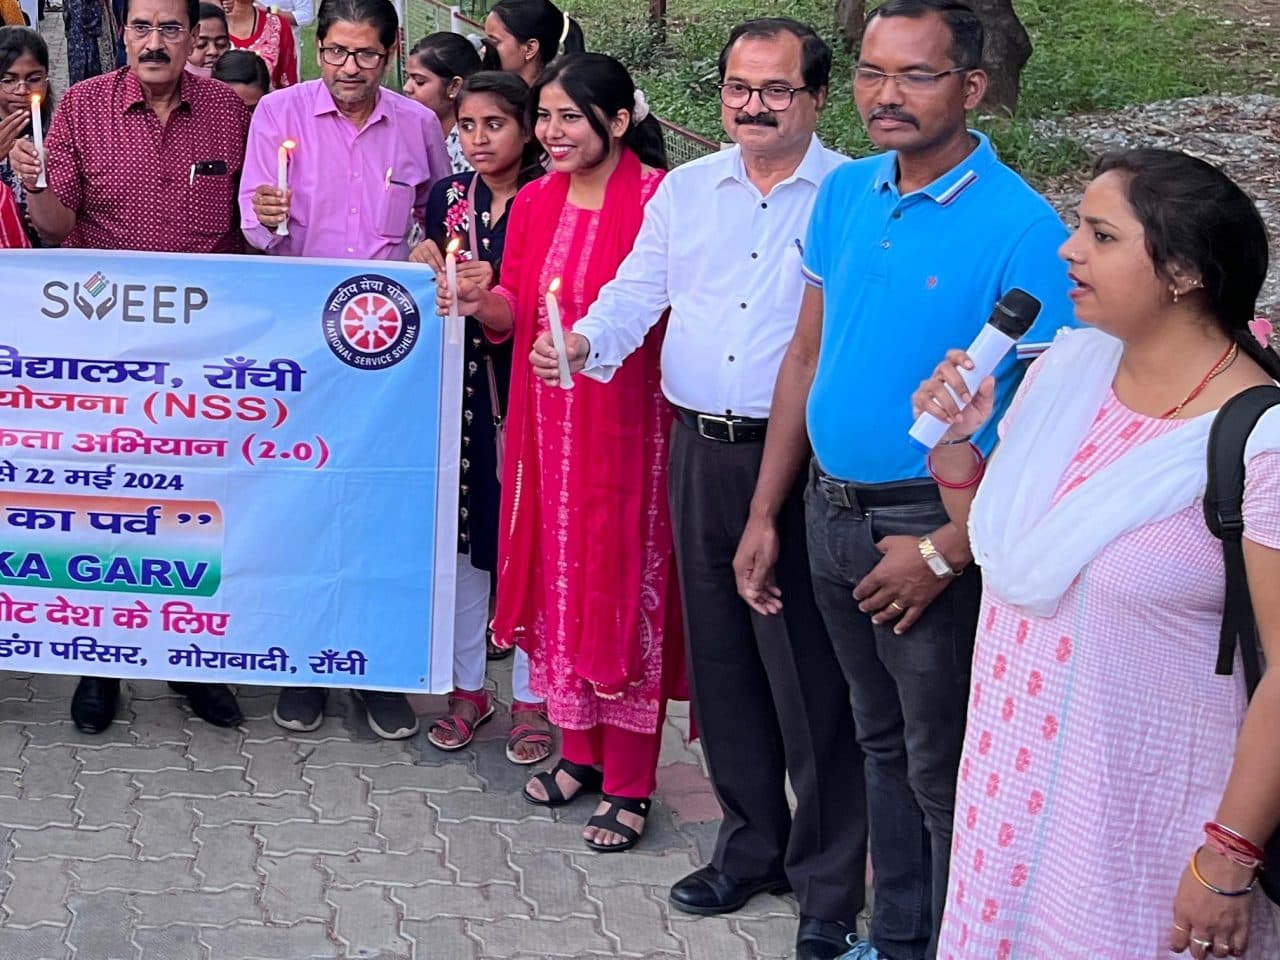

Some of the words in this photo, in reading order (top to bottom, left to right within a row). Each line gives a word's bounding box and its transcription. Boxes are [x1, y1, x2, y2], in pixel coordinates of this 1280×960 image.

[359, 276, 384, 292] सेवा
[387, 284, 416, 315] योजना
[326, 319, 354, 361] NATIONAL
[354, 353, 393, 366] SERVICE
[391, 324, 417, 359] SCHEME
[203, 355, 307, 392] राँची
[142, 391, 289, 429] (NSS)
[71, 427, 228, 458] अभियान
[241, 432, 330, 470] (2.0)
[25, 467, 56, 484] 22
[64, 463, 116, 490] मई
[122, 471, 185, 491] 2024
[5, 508, 77, 532] का
[87, 505, 162, 536] पर्व
[67, 554, 209, 589] GARV
[44, 595, 104, 628] देश
[111, 599, 153, 630] के
[159, 600, 231, 636] लिए
[167, 643, 298, 674] मोराबादी,
[307, 648, 369, 676] राँची
